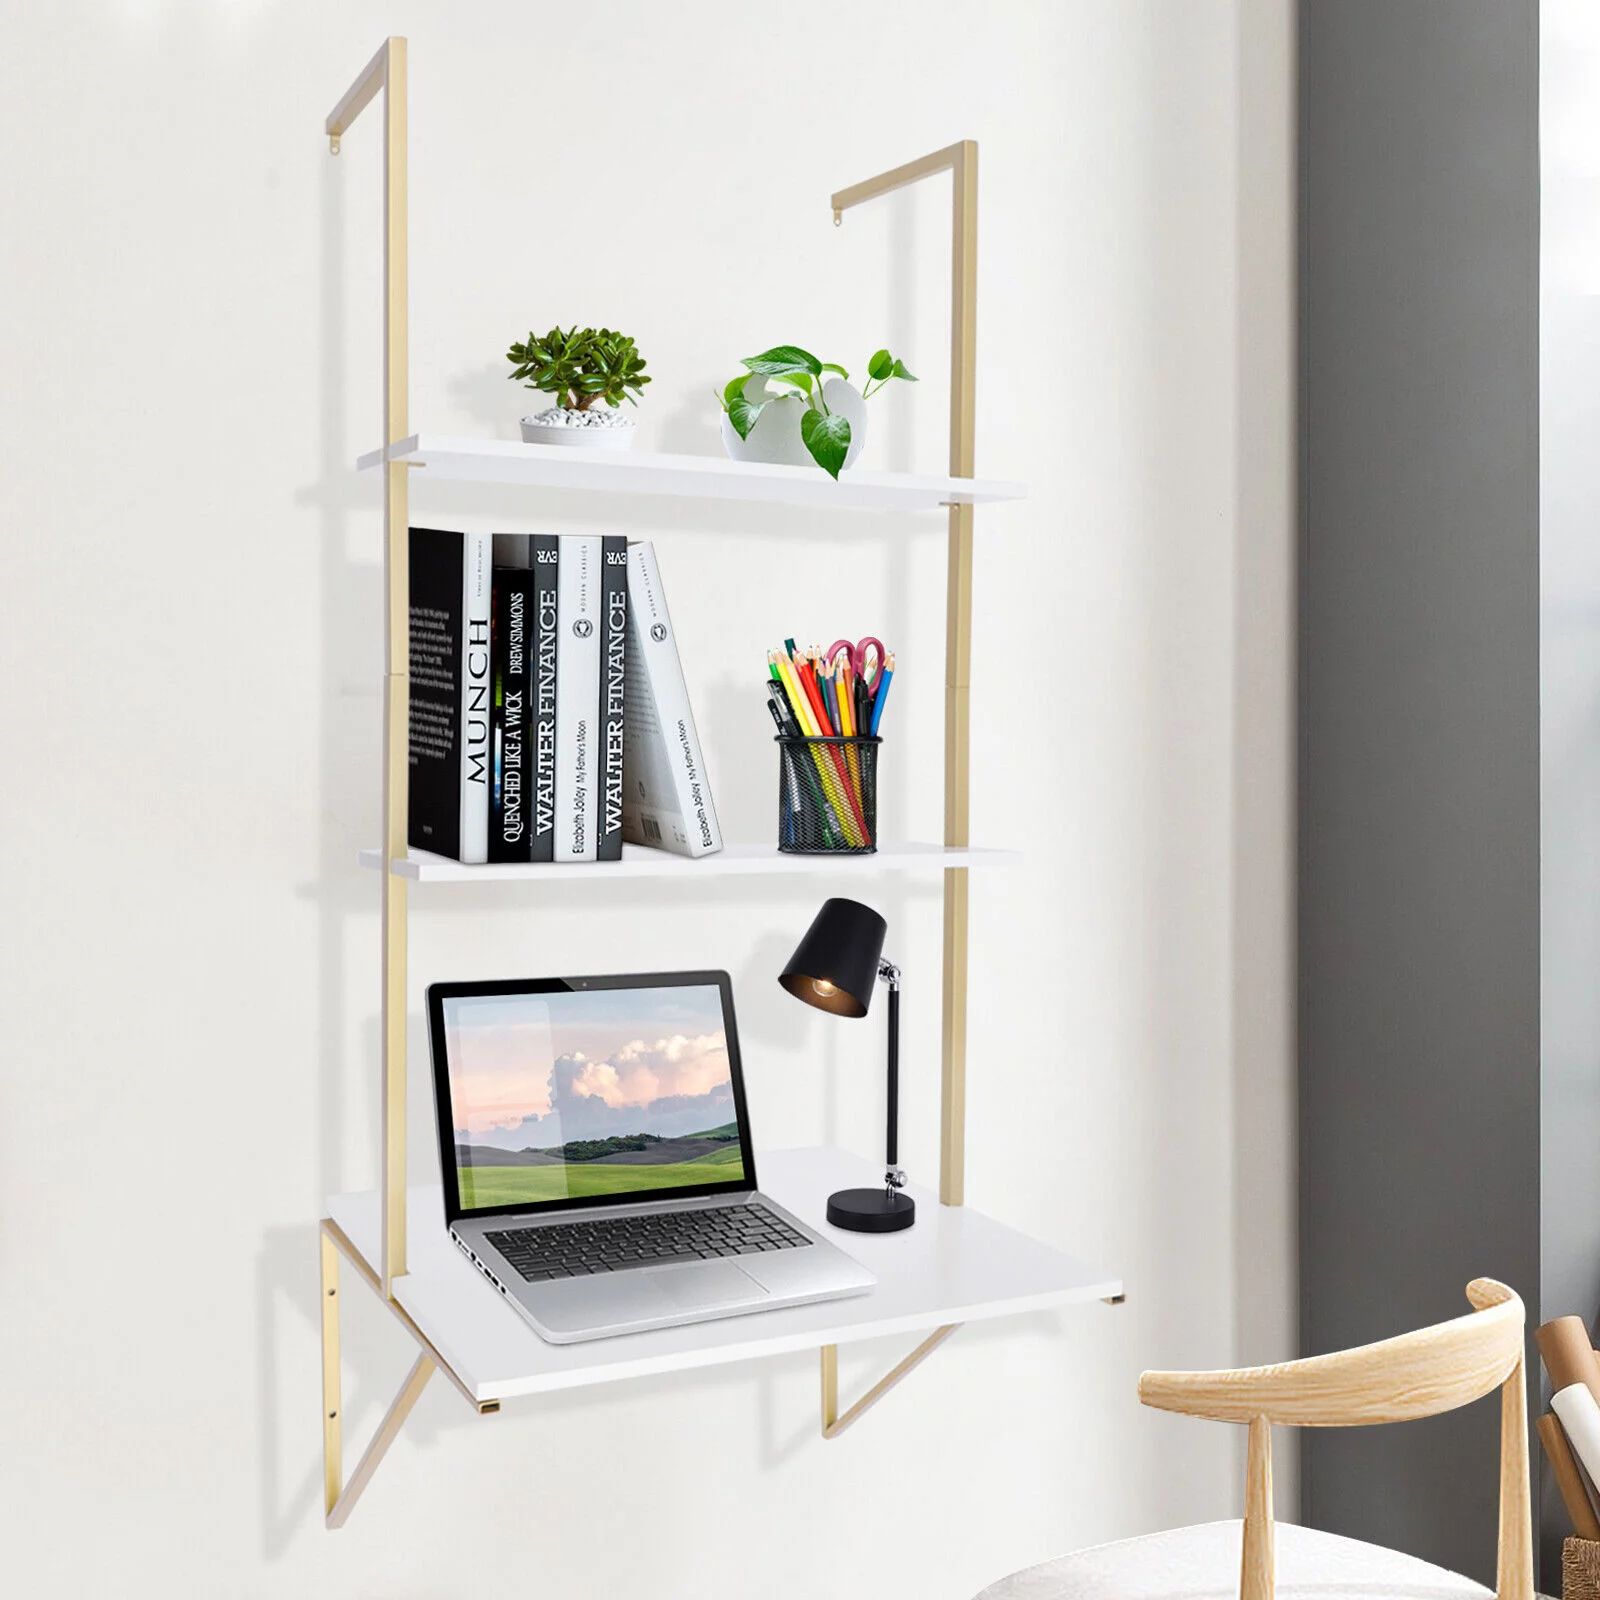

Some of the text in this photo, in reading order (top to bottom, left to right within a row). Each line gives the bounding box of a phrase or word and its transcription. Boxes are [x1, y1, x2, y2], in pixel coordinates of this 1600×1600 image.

[510, 592, 523, 674] DREW SIMMONS
[468, 620, 488, 784] MUNCH
[536, 590, 556, 836] WALTER FINANCE
[577, 720, 586, 742] Moon
[606, 592, 625, 834] WALTER FINANCE
[678, 720, 687, 742] Moon
[504, 690, 523, 842] QUENCHED LIKE A WICK
[576, 770, 586, 783] My
[688, 768, 697, 780] My
[572, 786, 587, 854] Elizabeth Jolley
[692, 783, 712, 847] Elizabeth Jolley
